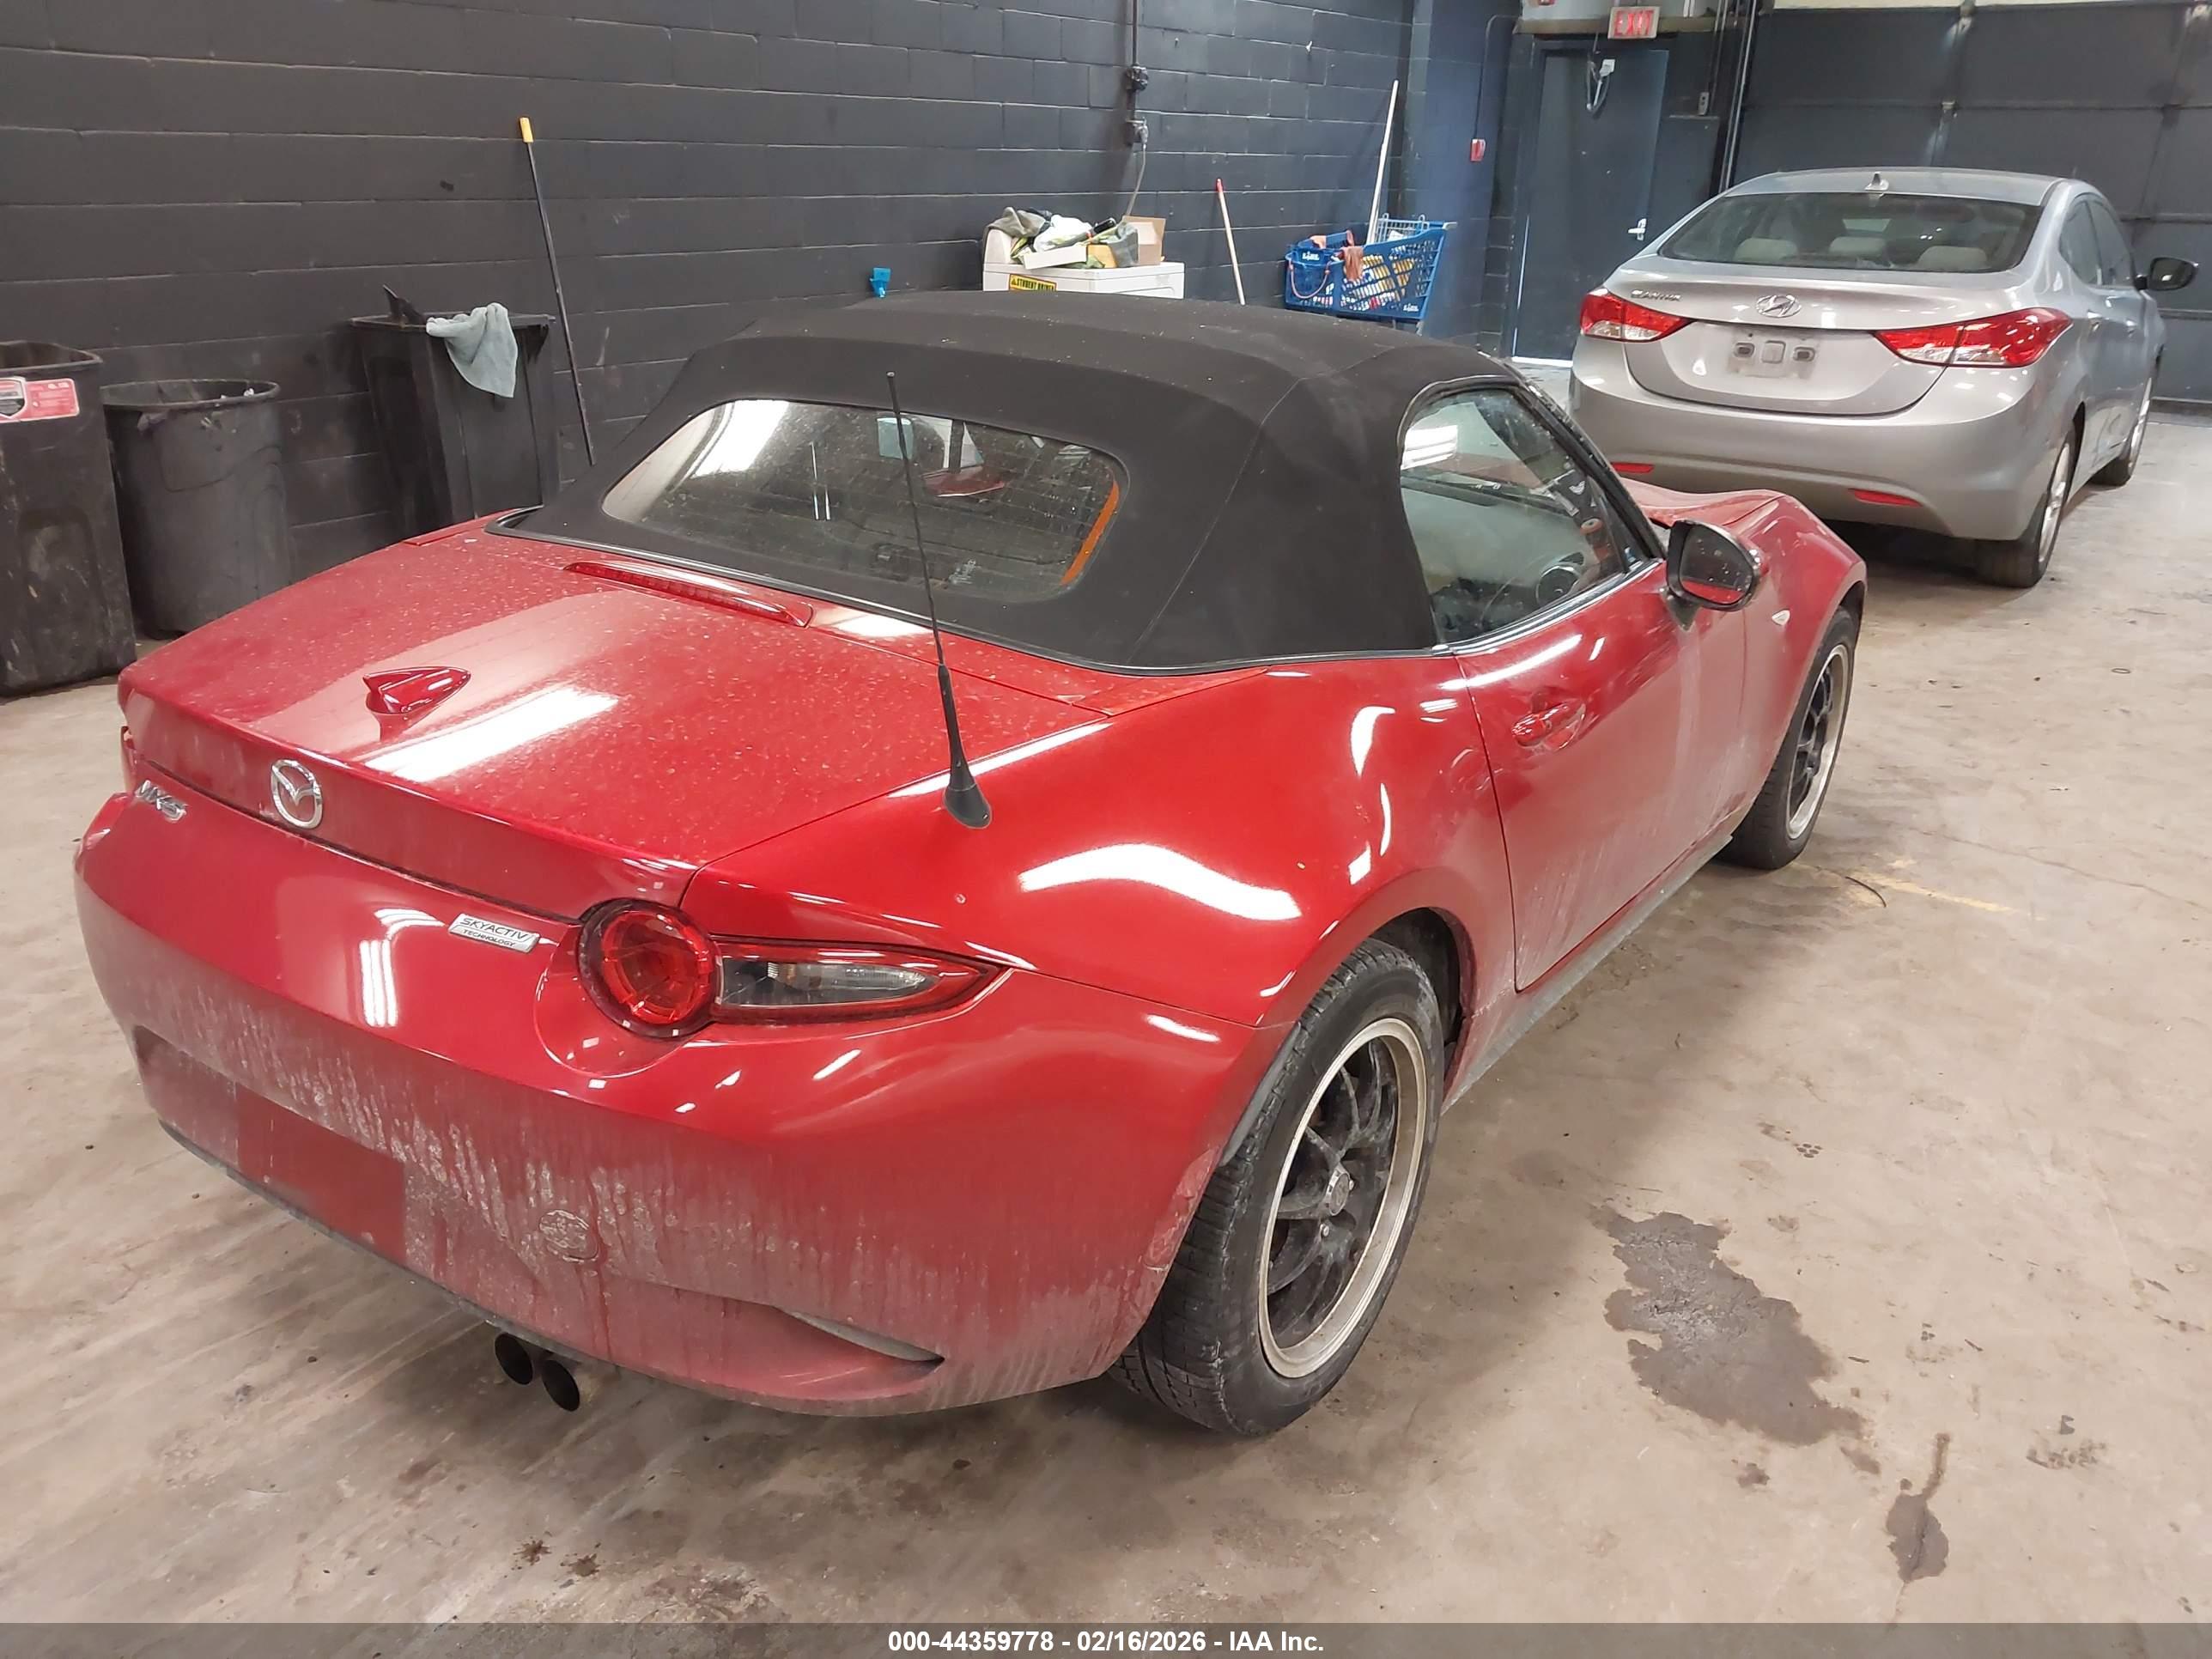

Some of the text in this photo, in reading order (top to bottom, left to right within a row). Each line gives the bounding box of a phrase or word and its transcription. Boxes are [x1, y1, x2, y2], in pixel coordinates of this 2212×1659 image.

[1613, 9, 1655, 36] EXIT
[459, 917, 528, 939] SKYACTIV
[463, 929, 516, 946] TECHNOLOGY
